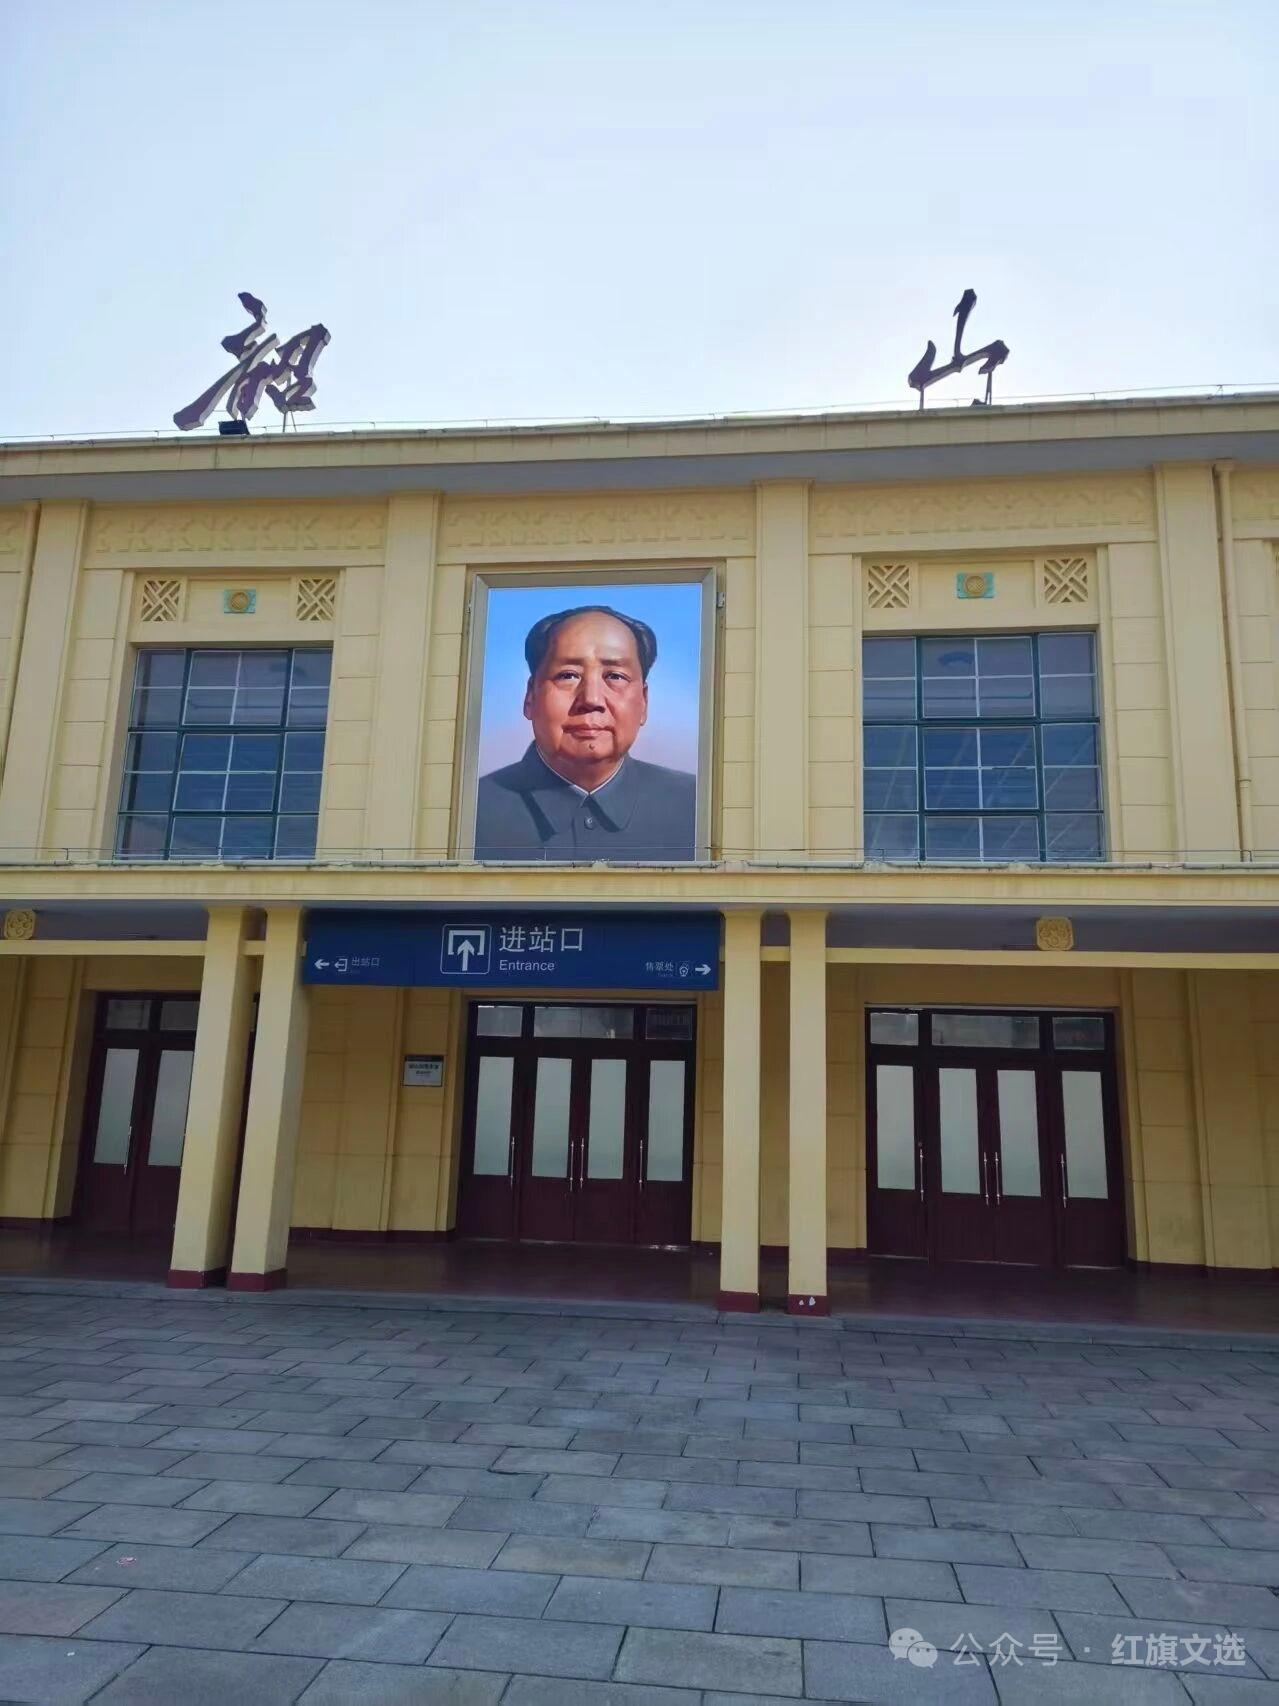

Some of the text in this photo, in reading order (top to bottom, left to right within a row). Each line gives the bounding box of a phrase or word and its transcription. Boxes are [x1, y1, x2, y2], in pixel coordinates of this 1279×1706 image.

[173, 288, 1010, 431] 韶 山
[499, 925, 584, 953] 进站口
[499, 959, 555, 971] Entrance
